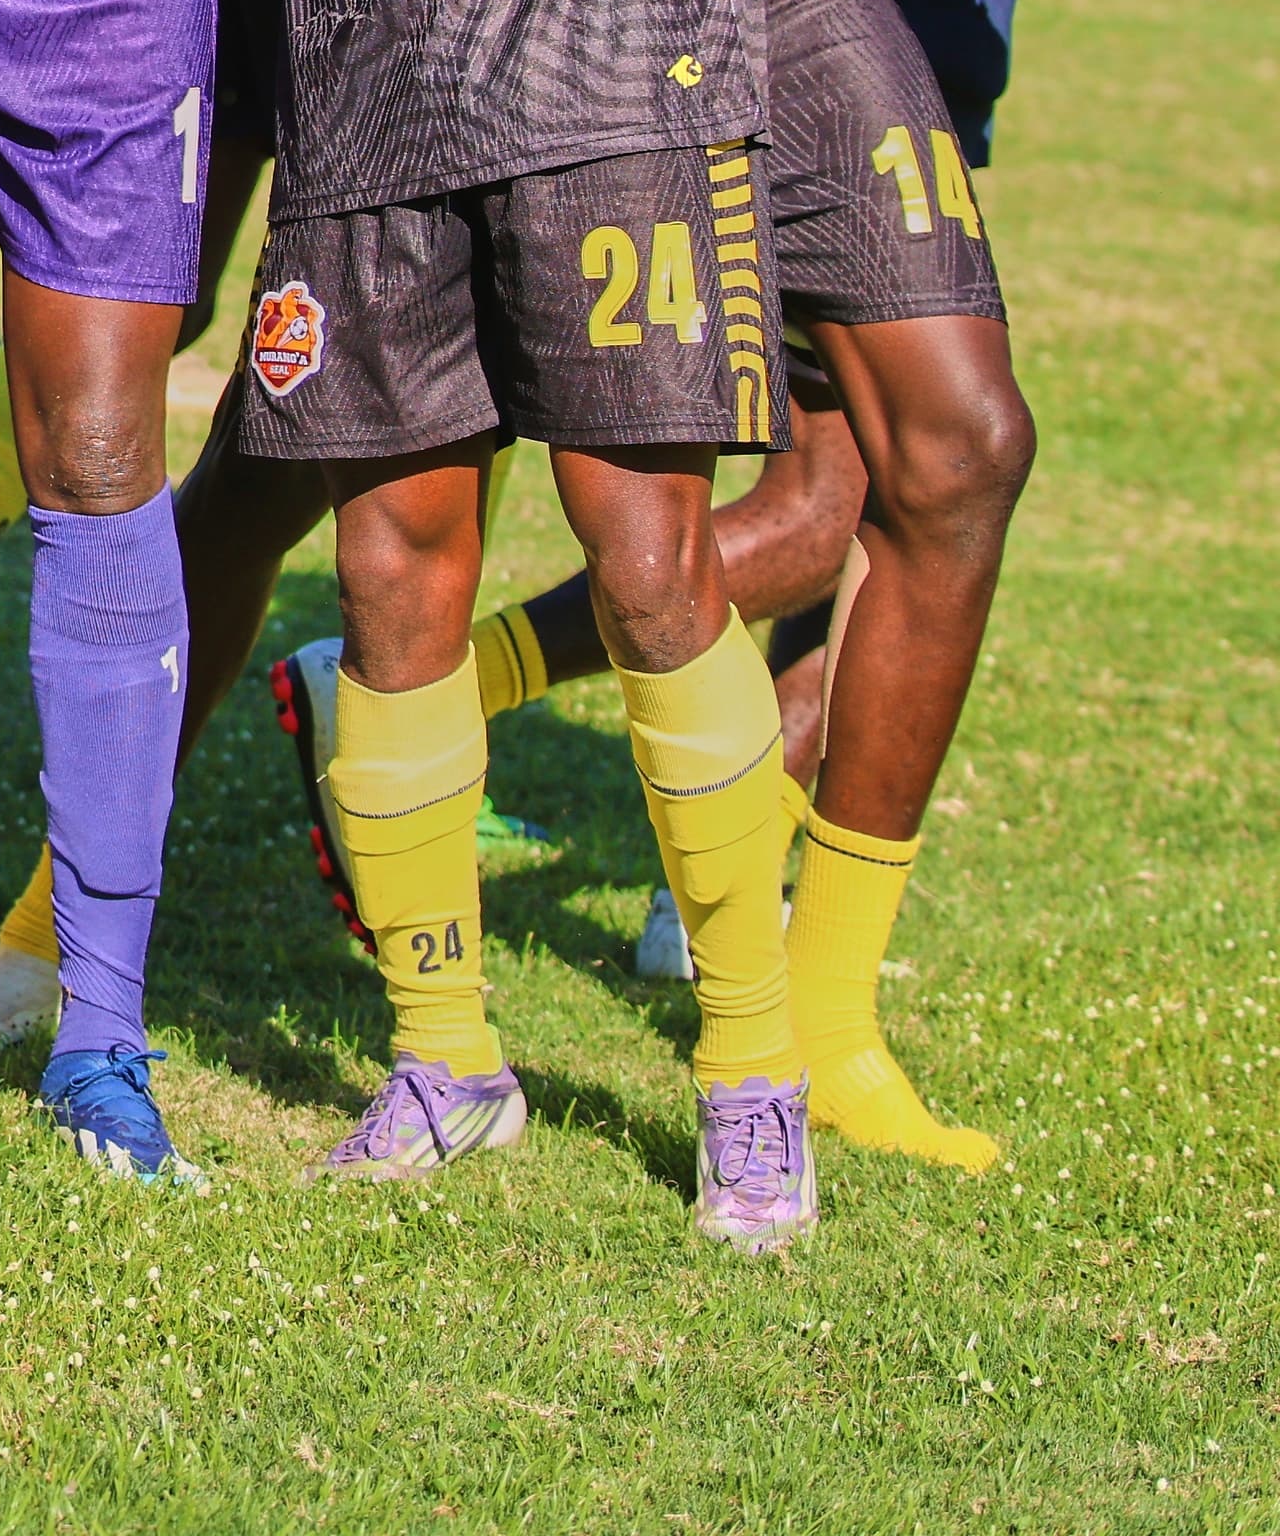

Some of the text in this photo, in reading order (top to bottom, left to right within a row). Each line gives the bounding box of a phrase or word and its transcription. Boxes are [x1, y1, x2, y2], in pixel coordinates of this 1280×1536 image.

[173, 87, 201, 204] 1
[871, 125, 981, 239] 14
[580, 221, 707, 348] 24
[268, 365, 290, 375] SEAL
[160, 646, 179, 693] 1
[410, 920, 465, 976] 24
